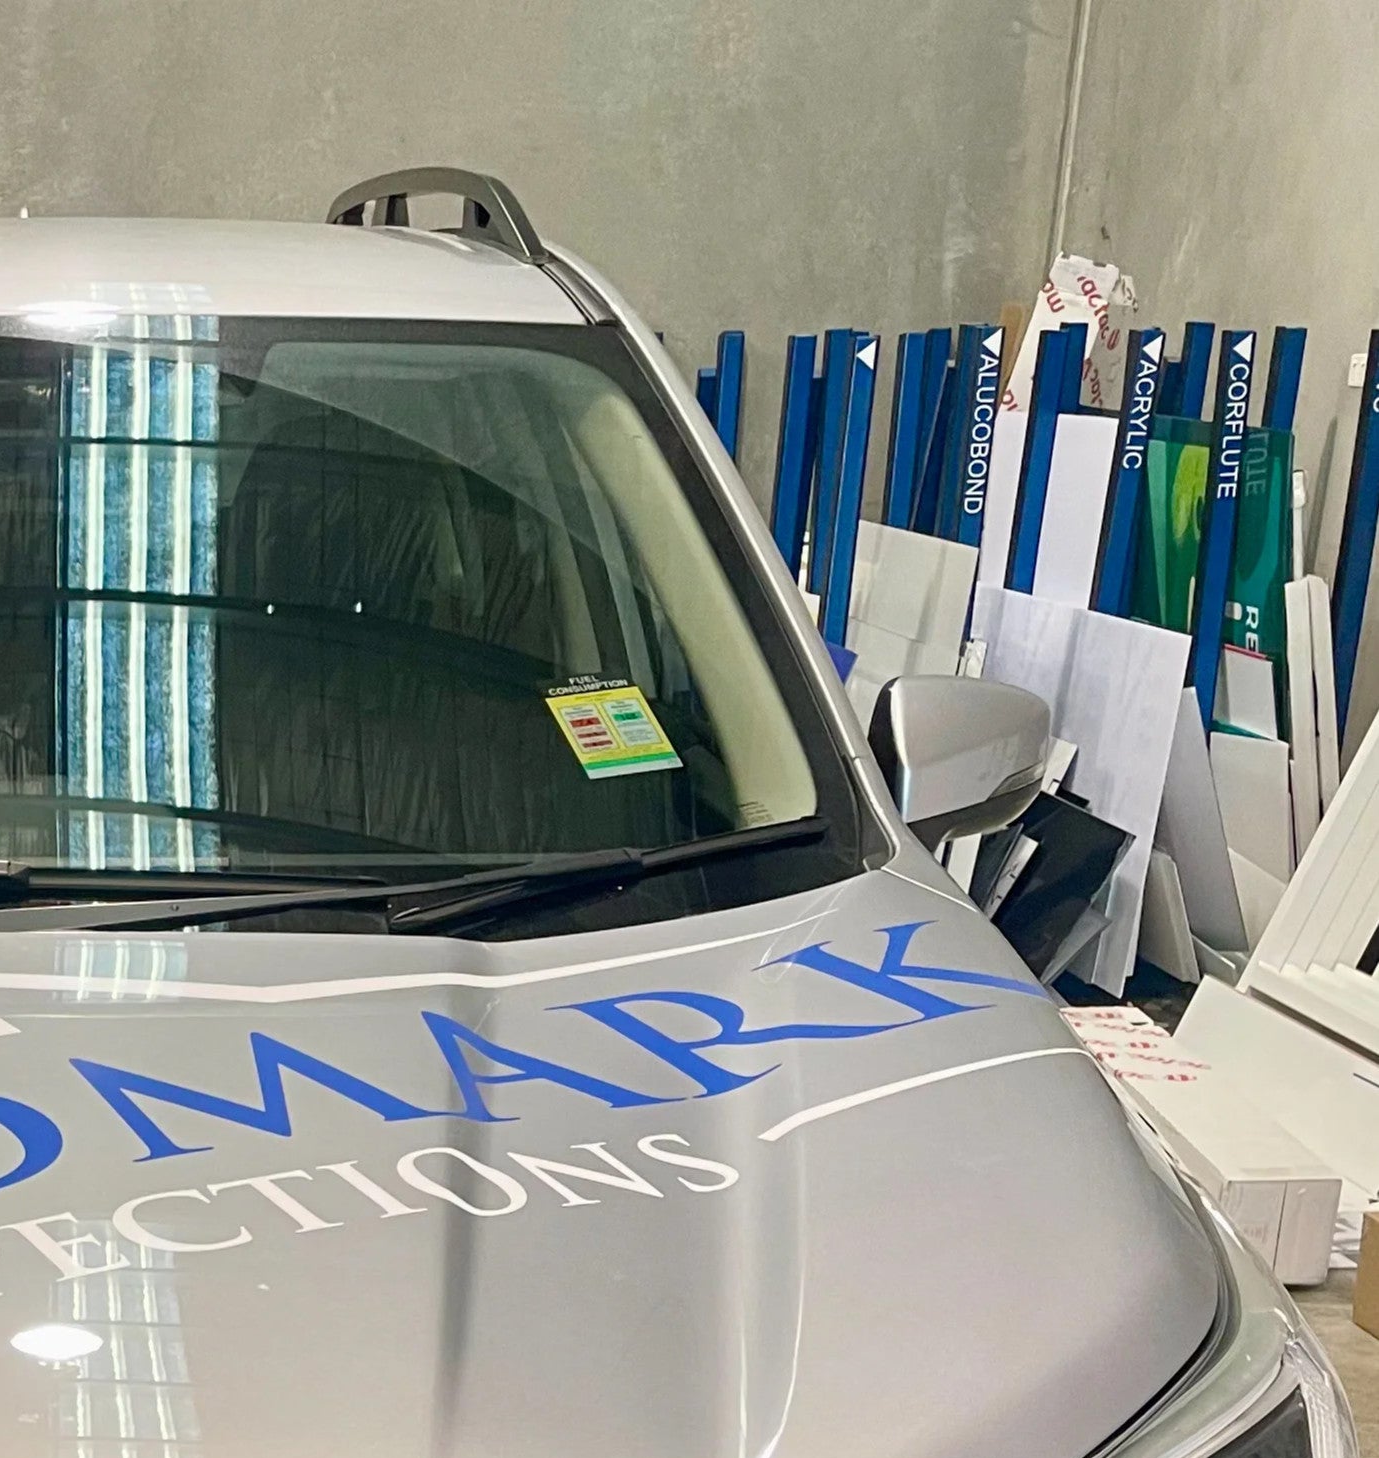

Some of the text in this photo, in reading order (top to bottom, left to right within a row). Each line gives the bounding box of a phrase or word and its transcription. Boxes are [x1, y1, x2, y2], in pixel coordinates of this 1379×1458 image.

[964, 353, 1000, 515] ALUCOBOND
[1122, 359, 1158, 470] ACRYLIC
[1216, 363, 1250, 499] CORFLUTE
[548, 679, 629, 696] CONSUMPTION
[568, 675, 600, 685] FUEL
